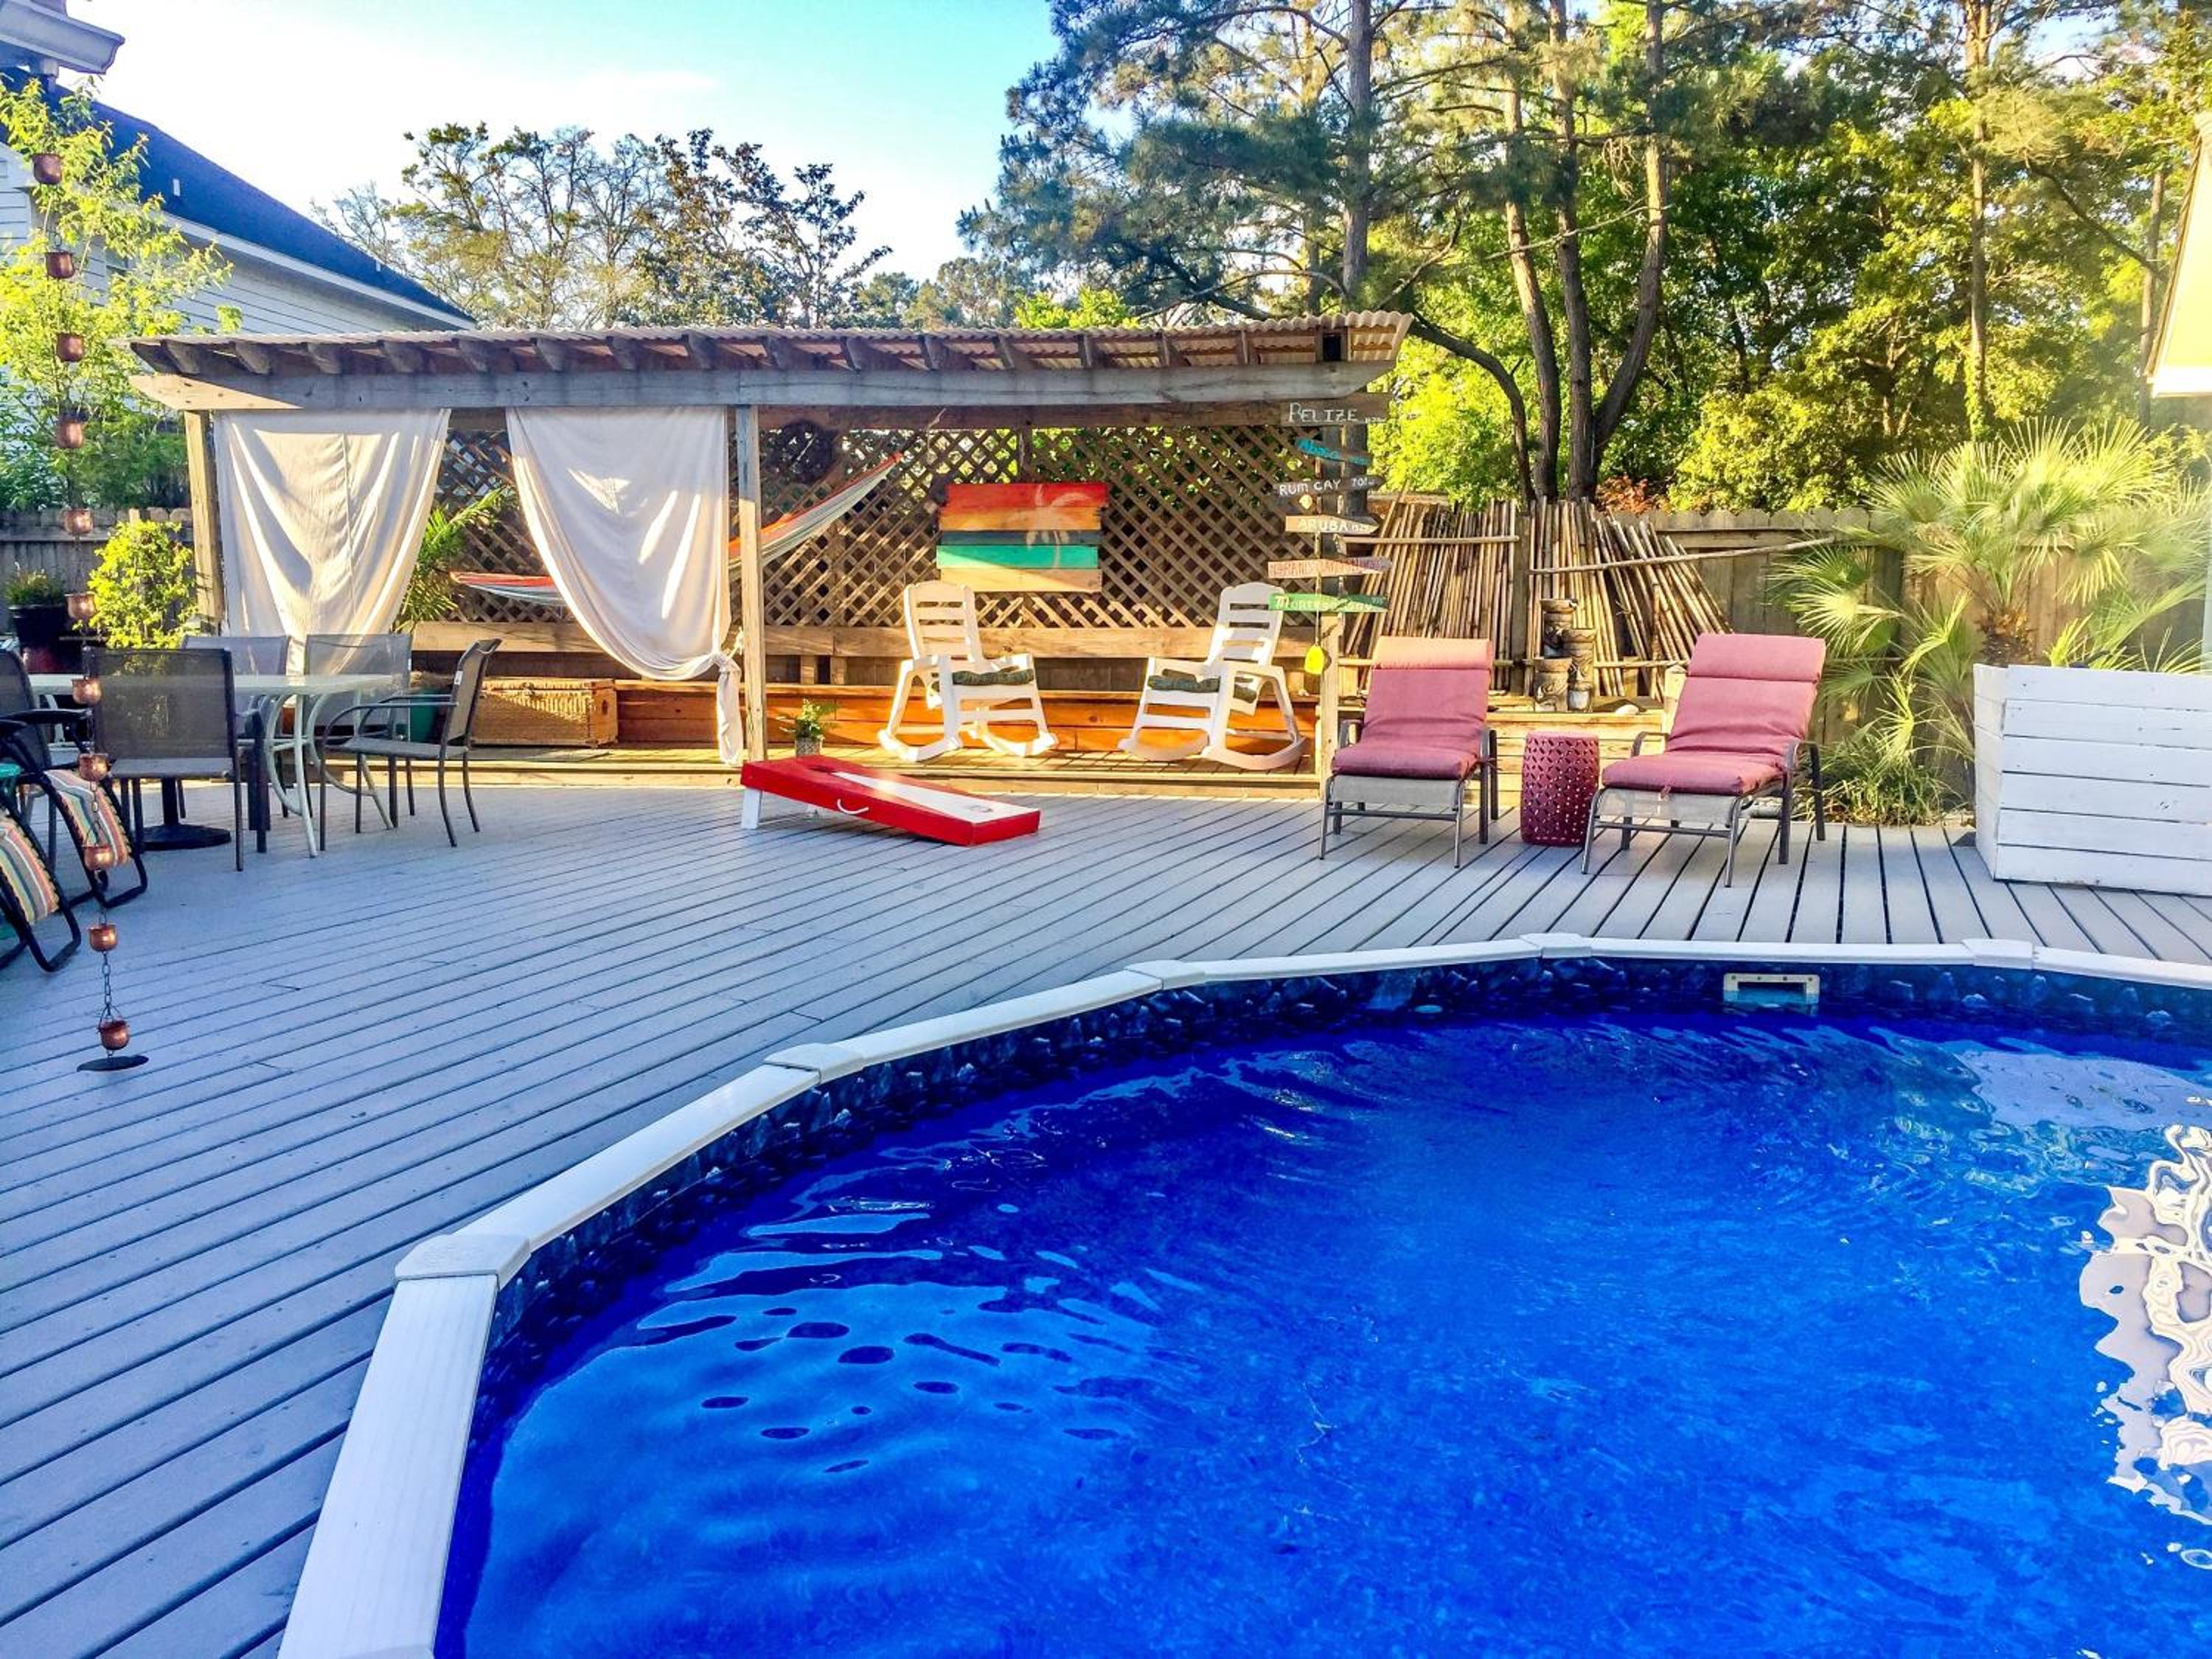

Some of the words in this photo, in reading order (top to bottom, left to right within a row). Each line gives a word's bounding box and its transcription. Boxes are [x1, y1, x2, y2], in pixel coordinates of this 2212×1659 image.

[1288, 402, 1357, 422] BELIZE
[1279, 484, 1308, 496] RUM
[1313, 479, 1341, 491] CAY
[1297, 518, 1349, 531] ARUBA
